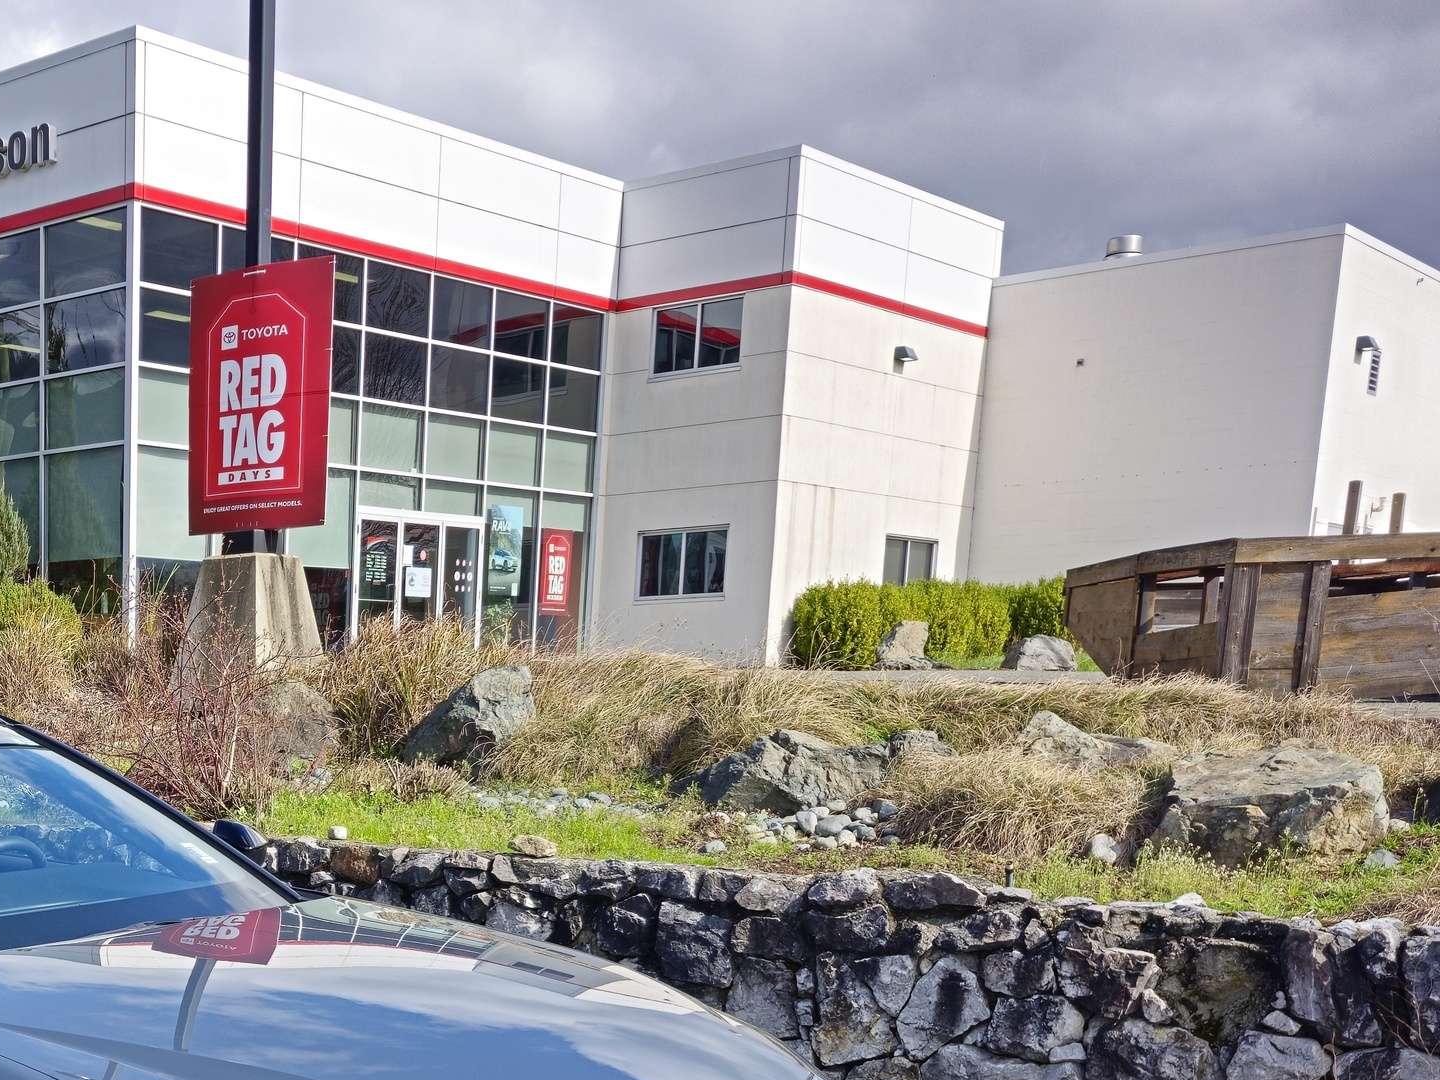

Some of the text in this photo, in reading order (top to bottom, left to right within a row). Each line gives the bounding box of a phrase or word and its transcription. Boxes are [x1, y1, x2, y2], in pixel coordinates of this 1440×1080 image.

[241, 325, 288, 341] TOYOTA
[220, 354, 287, 412] RED
[219, 410, 285, 468] TAG
[228, 470, 272, 483] DAYS
[277, 500, 303, 508] MODELS.
[549, 556, 566, 574] RED
[548, 575, 564, 595] TAG
